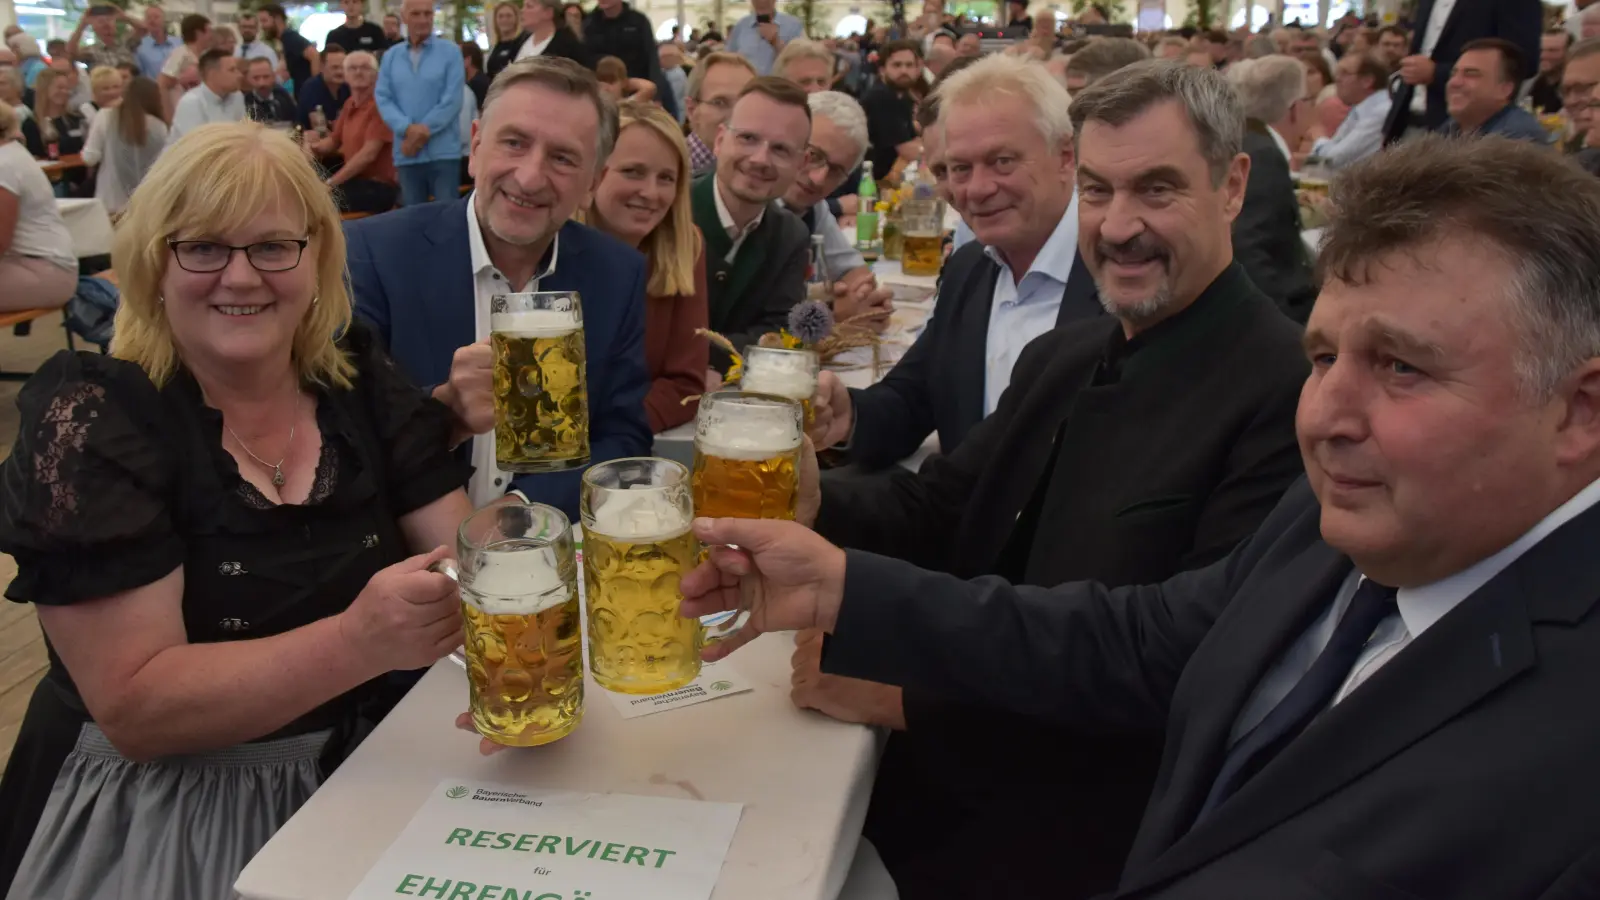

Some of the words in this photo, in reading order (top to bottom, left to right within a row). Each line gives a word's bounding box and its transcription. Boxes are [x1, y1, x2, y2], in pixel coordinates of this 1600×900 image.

[654, 690, 707, 705] Bayerischer
[476, 788, 528, 798] Bayerischer
[472, 794, 543, 807] BauernVerband
[445, 827, 676, 868] RESERVIERT
[534, 866, 551, 876] für
[395, 873, 592, 900] EHREN
